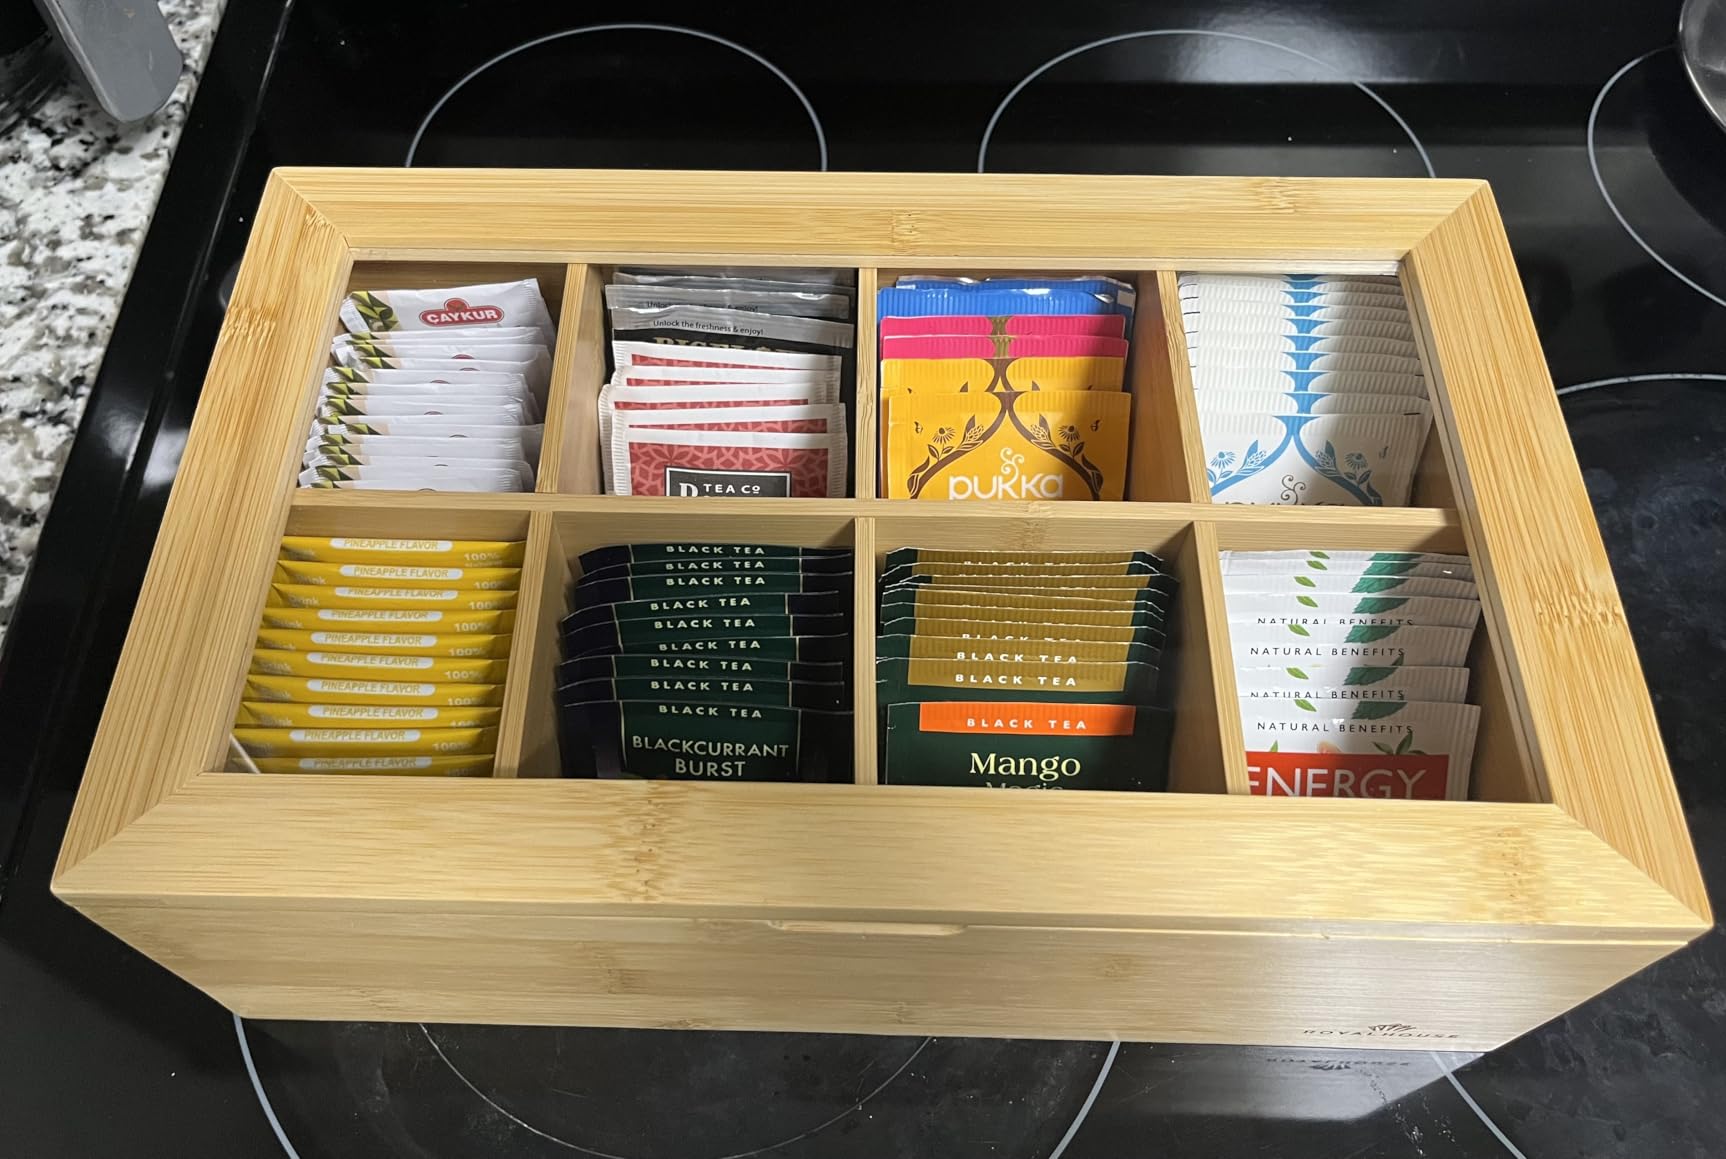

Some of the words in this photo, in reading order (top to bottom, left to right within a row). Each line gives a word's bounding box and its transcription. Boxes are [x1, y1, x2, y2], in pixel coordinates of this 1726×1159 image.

[653, 319, 680, 327] Unlock
[681, 320, 694, 328] the
[695, 321, 731, 332] freshness
[732, 325, 739, 333] &
[740, 327, 764, 336] enjoy!
[703, 483, 736, 494] TEA
[948, 472, 1064, 499] pukka
[666, 545, 724, 554] BLACK
[733, 546, 765, 555] TEA
[665, 561, 723, 570] BLACK
[733, 561, 764, 569] TEA
[353, 566, 408, 577] PINEAPPLE
[410, 568, 449, 578] FLAVOR
[666, 577, 723, 586] BLACK
[733, 577, 765, 585] TEA
[650, 600, 708, 610] BLACK
[719, 598, 750, 607] TEA
[654, 619, 712, 629] BLACK
[723, 619, 755, 628] TEA
[324, 632, 379, 643] PINEAPPLE
[381, 634, 422, 645] FLAVOR
[659, 641, 718, 651] BLACK
[729, 640, 760, 649] TEA
[956, 651, 1024, 662] BLACK
[1039, 654, 1078, 664] TEA
[1250, 647, 1322, 656] NATURAL
[1331, 647, 1405, 657] BENEFITS
[320, 653, 375, 665] PINEAPPLE
[377, 655, 419, 667] FLAVOR
[650, 659, 709, 670] BLACK
[720, 661, 752, 671] TEA
[650, 681, 709, 691] BLACK
[721, 682, 753, 692] TEA
[955, 674, 1023, 685] BLACK
[1038, 676, 1077, 687] TEA
[320, 680, 376, 692] PINEAPPLE
[378, 682, 421, 694] FLAVOR
[1331, 690, 1405, 699] BENEFITS
[322, 706, 378, 717] PINEAPPLE
[380, 707, 423, 718] FLAVOR
[659, 705, 718, 716] BLACK
[730, 708, 762, 719] TEA
[966, 718, 1033, 729] BLACK
[1048, 719, 1087, 730] TEA
[1257, 722, 1330, 732] NATURAL
[1339, 723, 1414, 734] BENEFITS
[304, 729, 361, 740] PINEAPPLE
[364, 730, 406, 740] FLAVOR
[632, 735, 789, 757] BLACKCURRANT
[675, 758, 746, 777] BURST
[969, 752, 1081, 782] Mango
[1303, 1030, 1460, 1038] ROYALHOUSE
